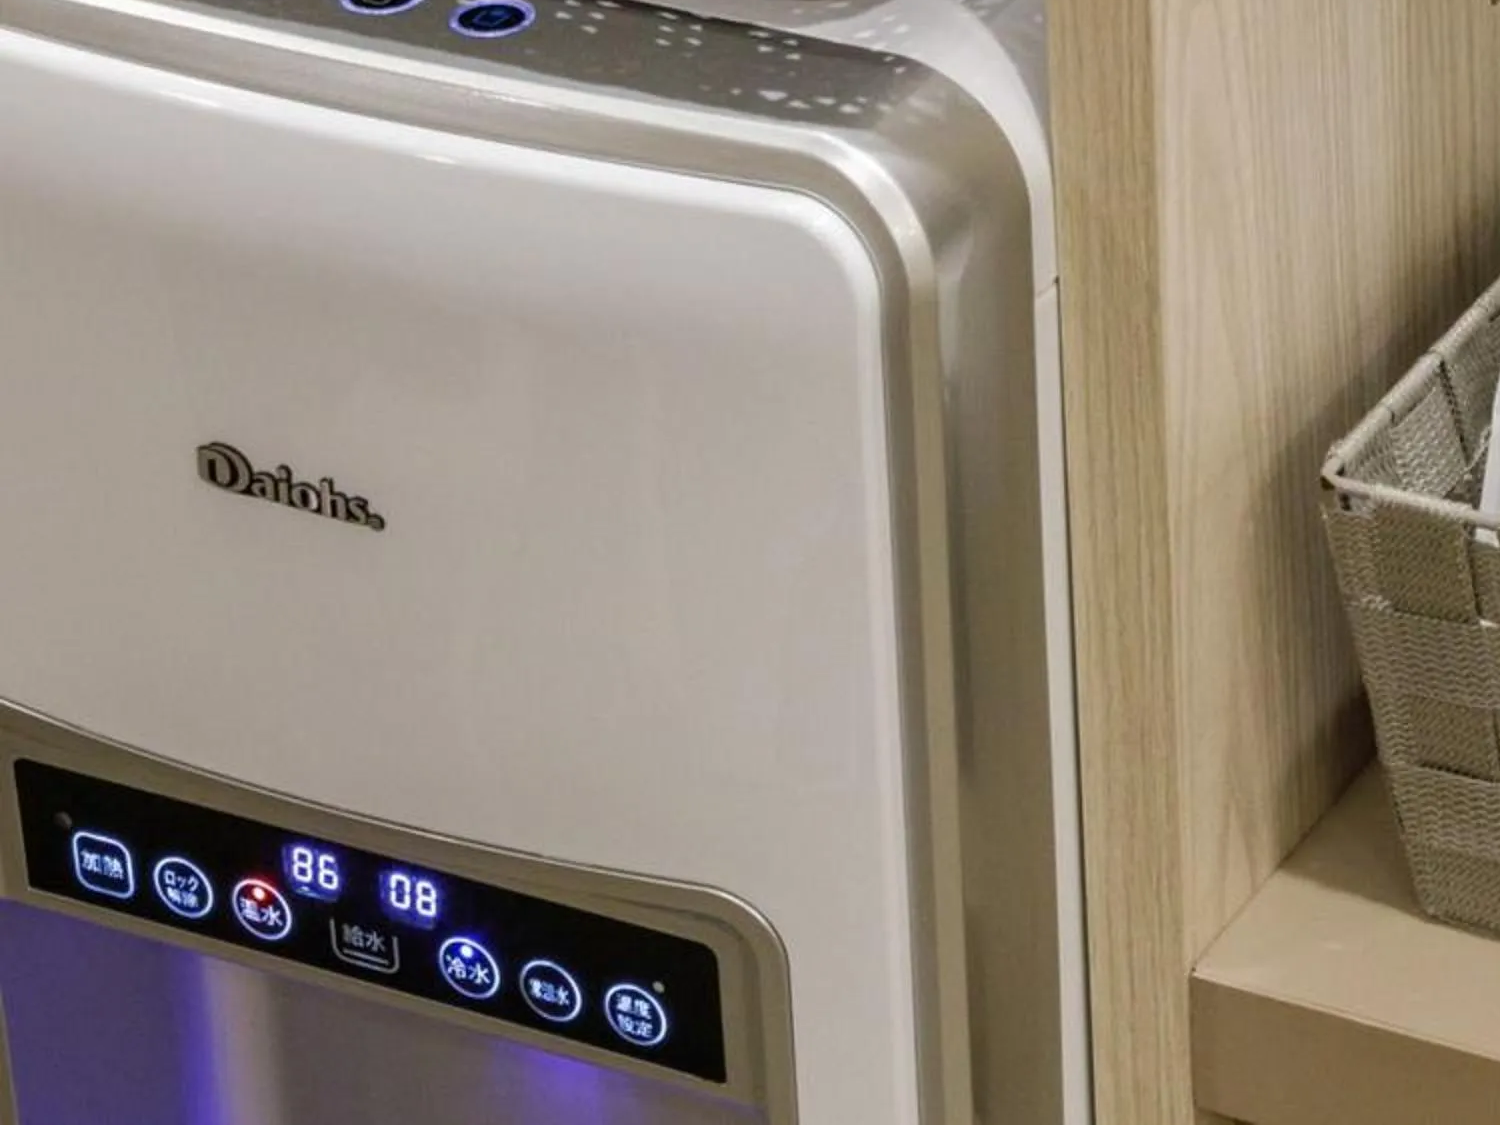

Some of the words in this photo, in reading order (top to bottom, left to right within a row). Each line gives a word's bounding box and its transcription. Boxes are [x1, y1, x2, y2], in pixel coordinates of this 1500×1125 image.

[163, 869, 200, 892] ロック
[292, 846, 339, 891] 86
[389, 873, 438, 917] 08
[239, 896, 283, 927] 温水
[445, 954, 491, 985] 冷水
